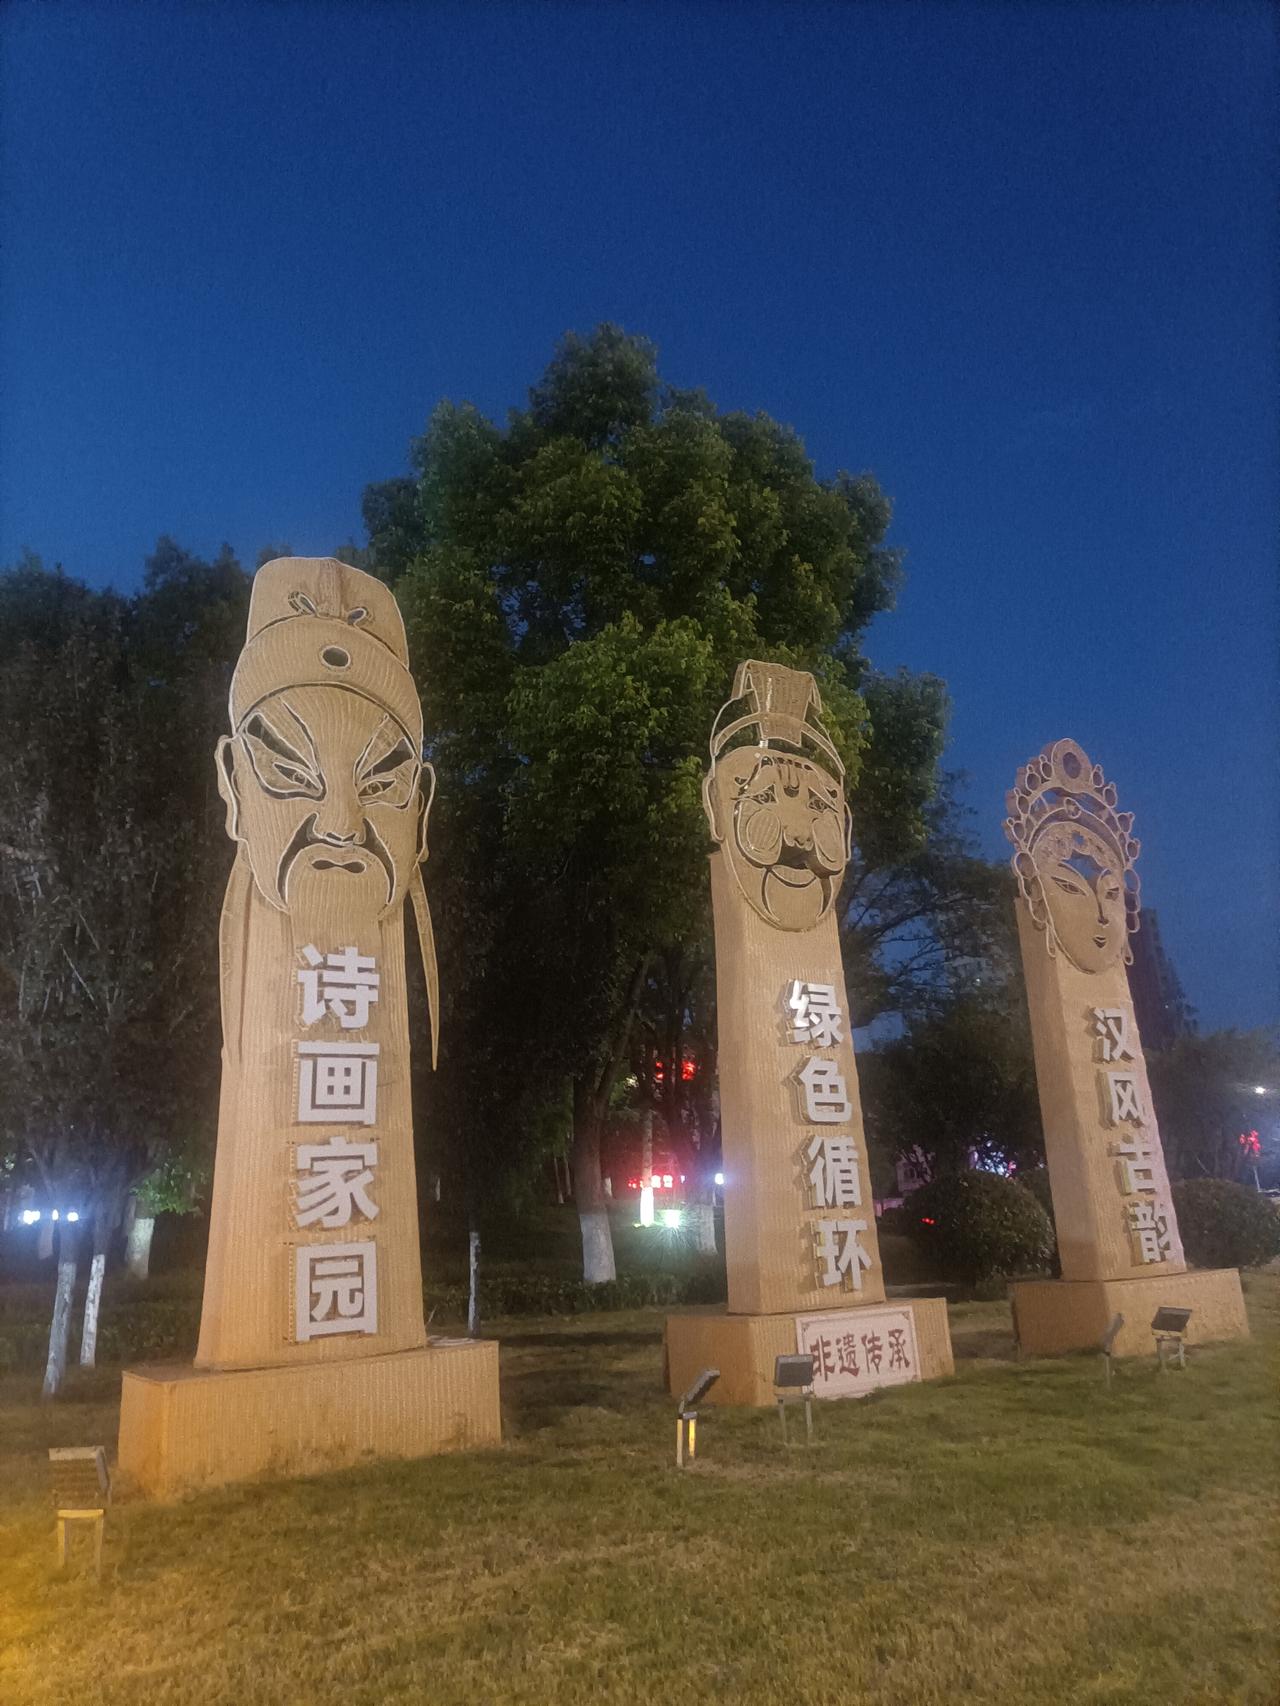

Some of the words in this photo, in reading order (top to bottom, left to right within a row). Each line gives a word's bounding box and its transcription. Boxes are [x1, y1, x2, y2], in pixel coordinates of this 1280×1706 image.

[295, 943, 380, 1342] 诗画家园
[789, 980, 872, 1291] 绿色循环
[1094, 1006, 1174, 1264] 汉风古韵
[810, 1328, 911, 1382] 非遗传承
